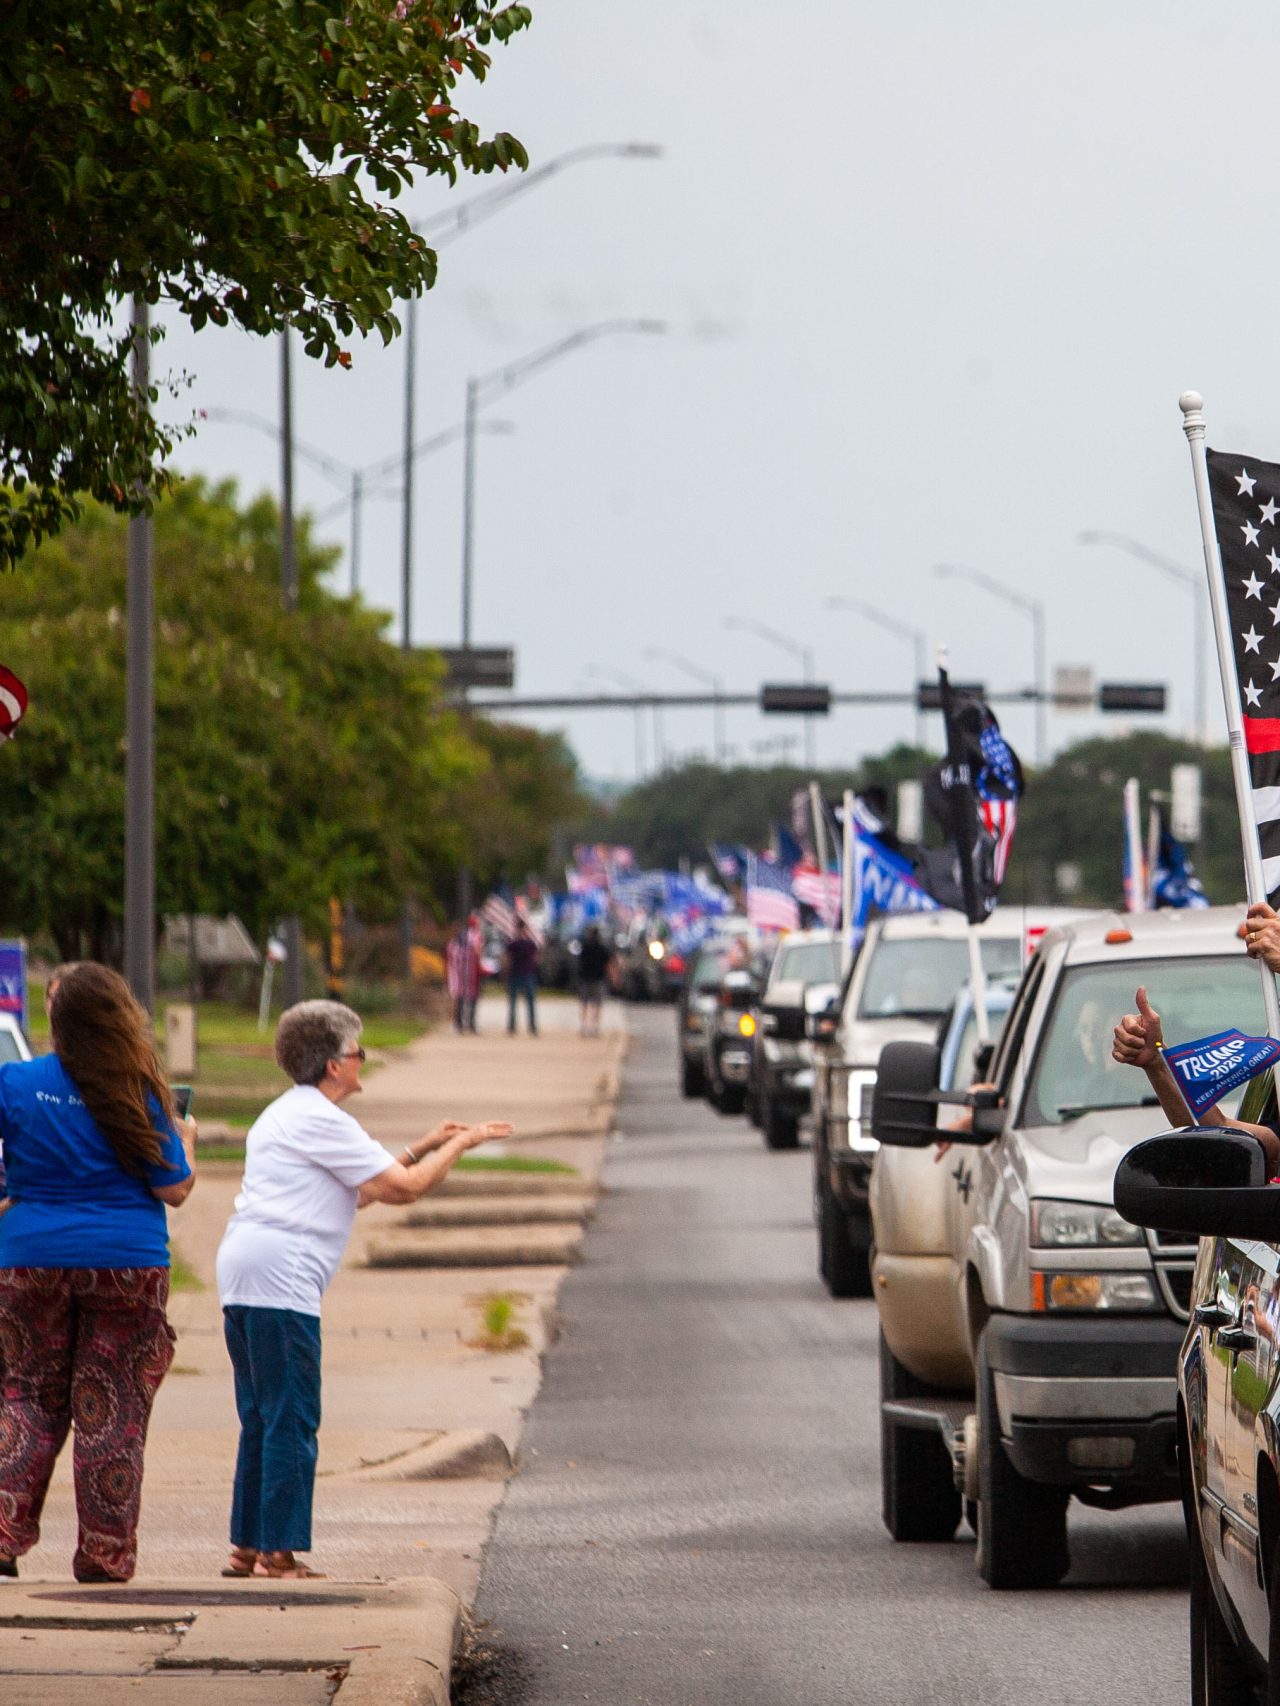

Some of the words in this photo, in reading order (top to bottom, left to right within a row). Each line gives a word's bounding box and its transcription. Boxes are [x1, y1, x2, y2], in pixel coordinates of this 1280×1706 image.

[1175, 1039, 1245, 1081] TRUMP
[1195, 1087, 1216, 1105] KEEP
[1215, 1065, 1250, 1092] AMERICA
[1248, 1044, 1274, 1068] GREAT!
